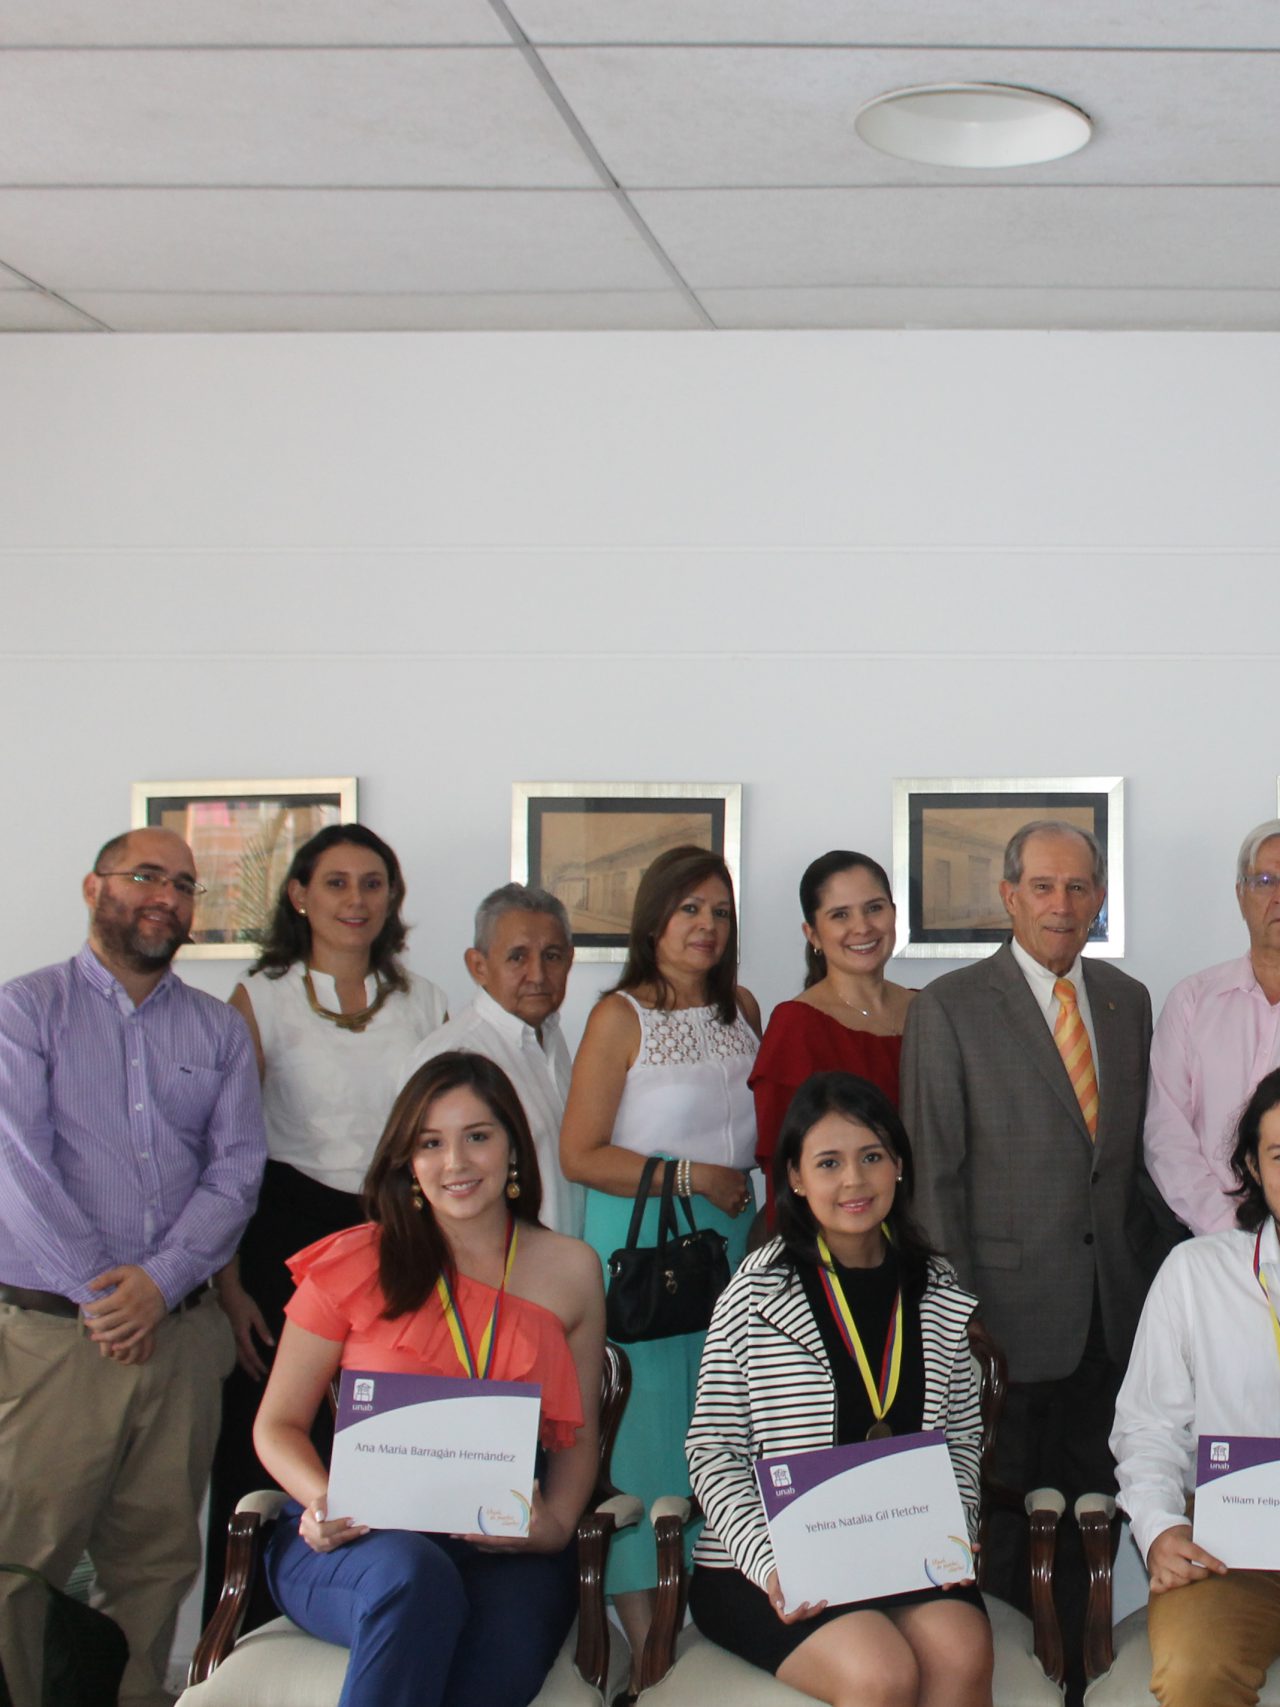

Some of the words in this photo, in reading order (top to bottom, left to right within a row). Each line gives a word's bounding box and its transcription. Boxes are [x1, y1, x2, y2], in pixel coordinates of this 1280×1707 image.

[352, 1404, 373, 1412] unab
[355, 1443, 375, 1453] Ana
[1210, 1462, 1230, 1470] unab
[776, 1487, 796, 1496] unab
[805, 1519, 837, 1534] Yehira
[839, 1513, 874, 1528] Natalia
[875, 1510, 890, 1522] Gil
[892, 1503, 930, 1519] Fletcher
